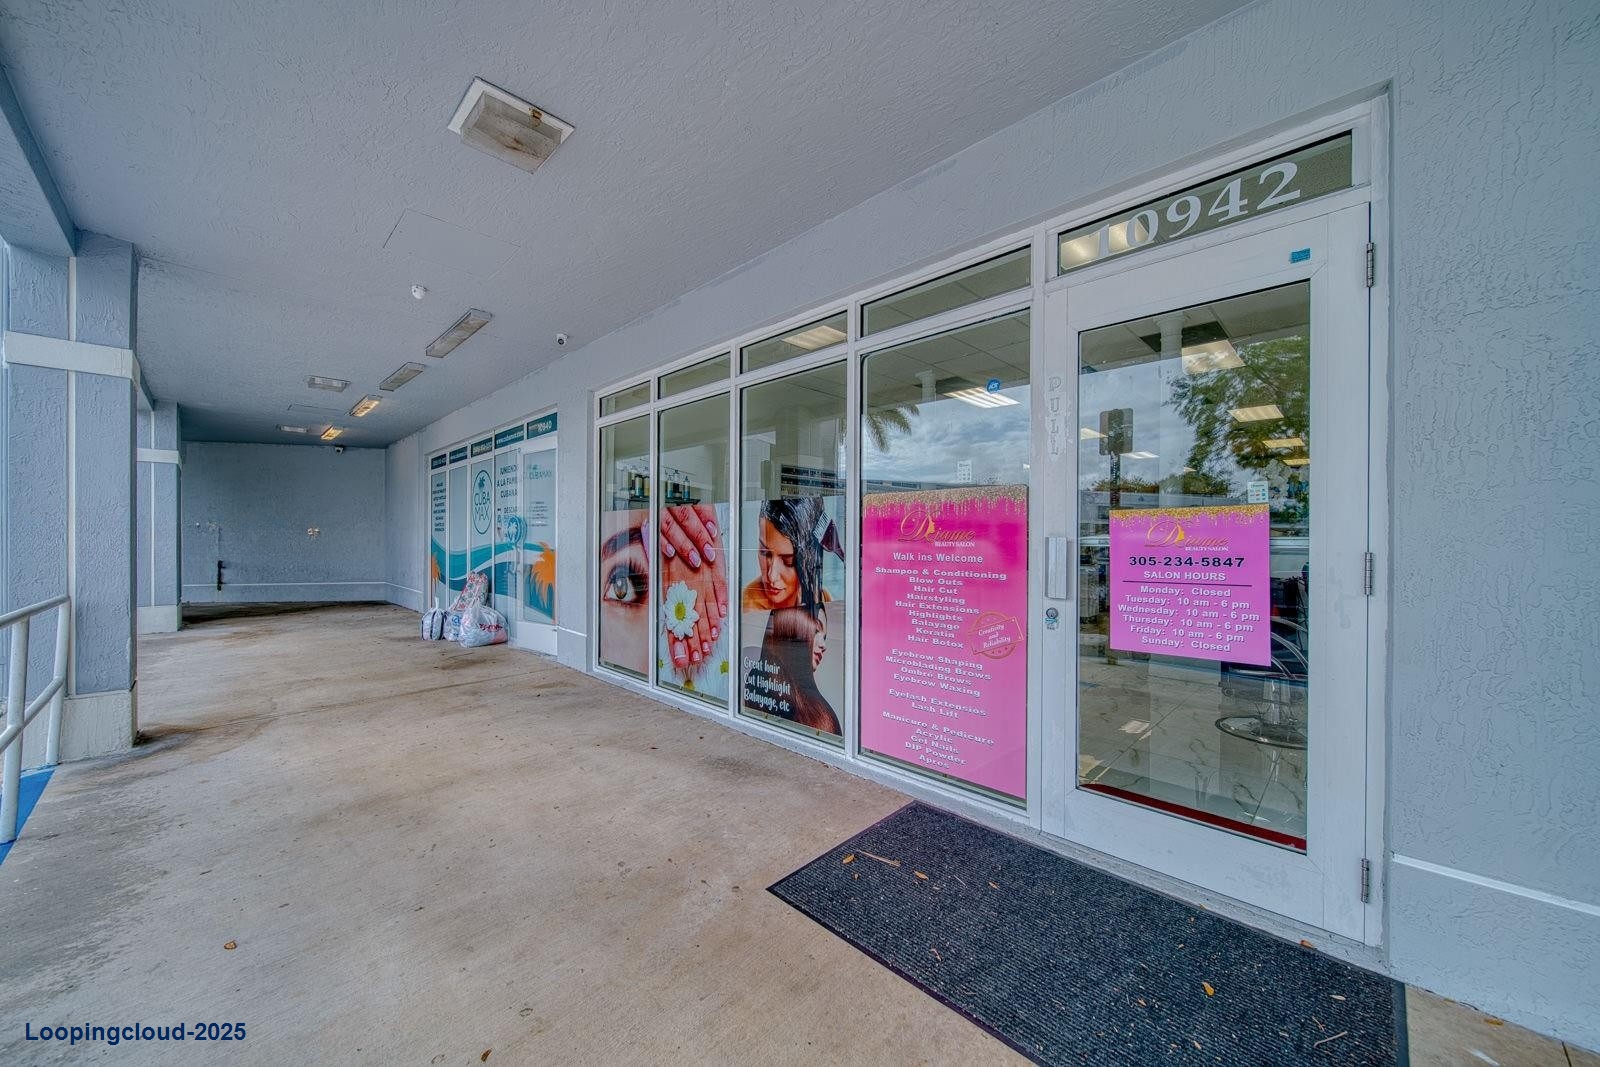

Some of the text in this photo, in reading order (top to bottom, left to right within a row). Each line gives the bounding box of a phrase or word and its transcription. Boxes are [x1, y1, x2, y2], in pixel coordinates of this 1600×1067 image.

[1094, 162, 1301, 258] 10942
[474, 492, 490, 506] CUBA
[475, 506, 489, 521] MAX
[893, 553, 983, 564] Walk ins Welcome
[1129, 556, 1244, 568] 305-234-5847
[875, 567, 918, 576] Shampoo
[934, 570, 1007, 581] Conditioning
[1144, 571, 1226, 581] SALON HOURS
[907, 593, 965, 604] Hairstyling
[1141, 586, 1231, 597] Monday: Closed
[919, 603, 980, 614] Extensions
[1126, 595, 1170, 605] Tuesday:
[1178, 597, 1189, 605] 10
[1221, 600, 1228, 608] 6
[1232, 602, 1250, 610] pm
[909, 610, 963, 622] Highlights
[1118, 604, 1179, 616] Wednesday:
[1187, 608, 1198, 617] 10
[1231, 611, 1238, 619] 6
[1242, 614, 1260, 622] pm
[911, 619, 960, 630] Balayage
[979, 624, 1004, 636] Creativity
[1123, 615, 1173, 626] Thursday:
[1181, 618, 1192, 627] 10
[1224, 621, 1232, 630] 6
[1236, 624, 1253, 632] pm
[916, 628, 955, 638] Keratin
[989, 631, 999, 640] and
[1130, 625, 1166, 636] Friday:
[1172, 628, 1184, 637] 10
[1188, 631, 1204, 639] am
[1216, 632, 1223, 640] 6
[1227, 634, 1244, 642] pm
[907, 635, 964, 649] Hair Botox
[983, 636, 1010, 648] Reliability
[1142, 636, 1231, 652] Sunday: Closed
[744, 656, 780, 674] Great hair
[892, 649, 983, 670] Eyebrow Shaping
[885, 656, 991, 680] Microblading Brows
[744, 673, 790, 696] Cut Highlight
[894, 674, 981, 697] Eyebrow Waxing
[938, 674, 971, 685] Brows
[744, 688, 790, 712] Balayage, etc
[889, 688, 927, 702] Eyelash
[911, 702, 960, 719] Lash Lift
[882, 711, 994, 745] Manicure & Pedicure
[915, 728, 953, 743] Acrylic
[911, 735, 960, 754] Gel Nails
[919, 754, 949, 769] Apres
[925, 747, 966, 765] Powder
